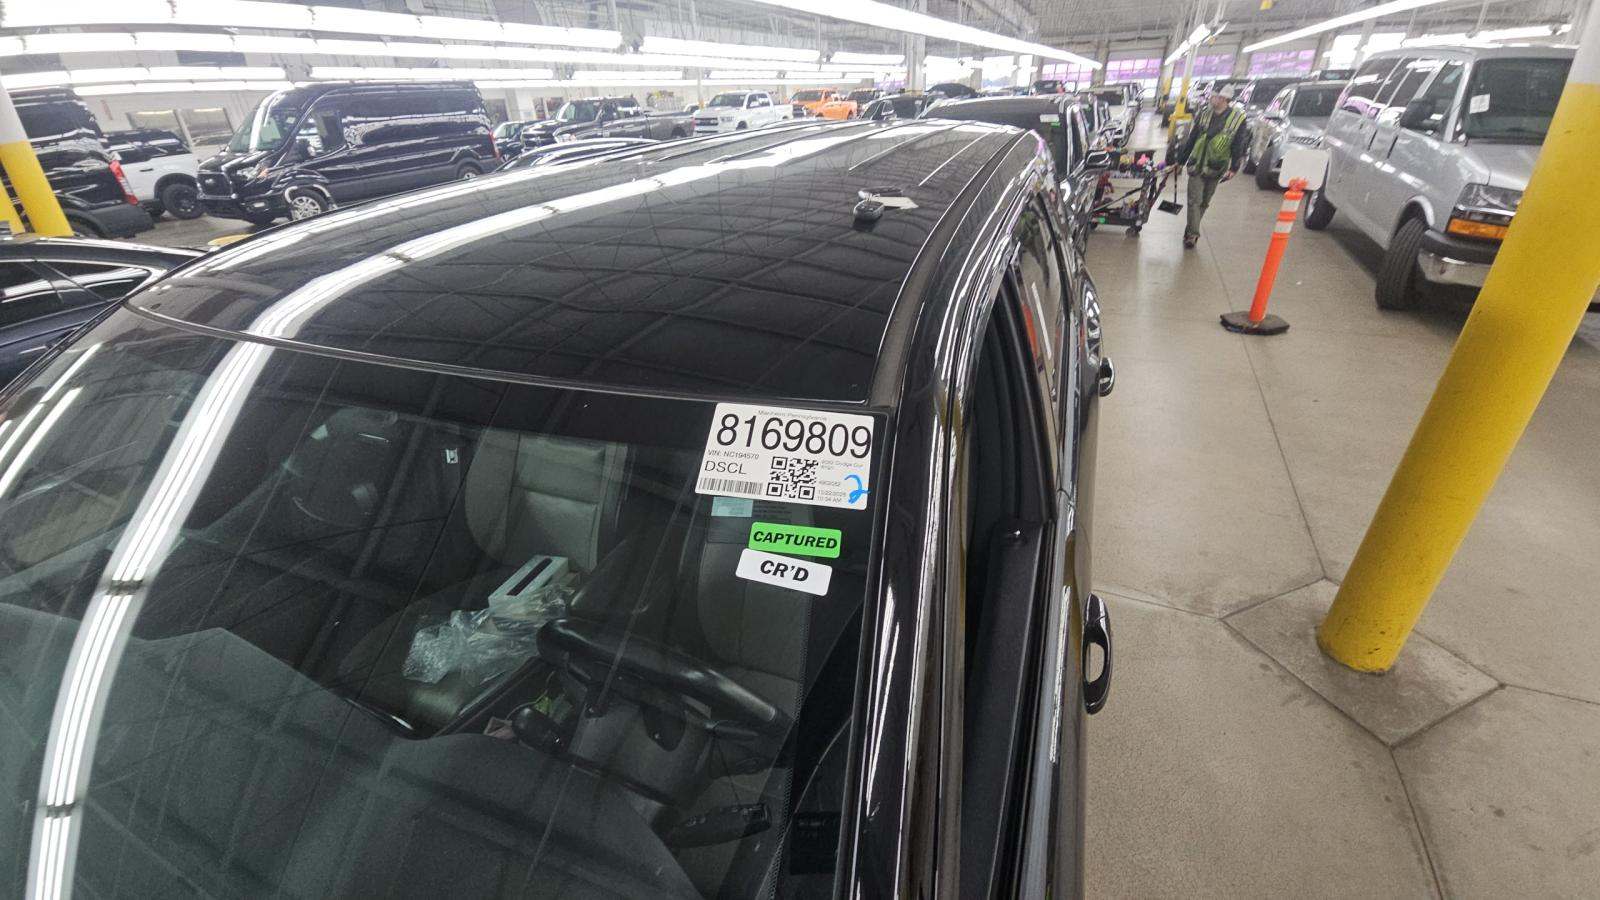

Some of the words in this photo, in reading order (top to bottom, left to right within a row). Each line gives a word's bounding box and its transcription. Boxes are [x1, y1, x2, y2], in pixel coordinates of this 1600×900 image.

[717, 413, 872, 459] 8169809
[723, 450, 760, 460] NC194570
[704, 460, 747, 475] DSCL
[753, 530, 838, 549] CAPTURED
[760, 560, 809, 582] CR'D
